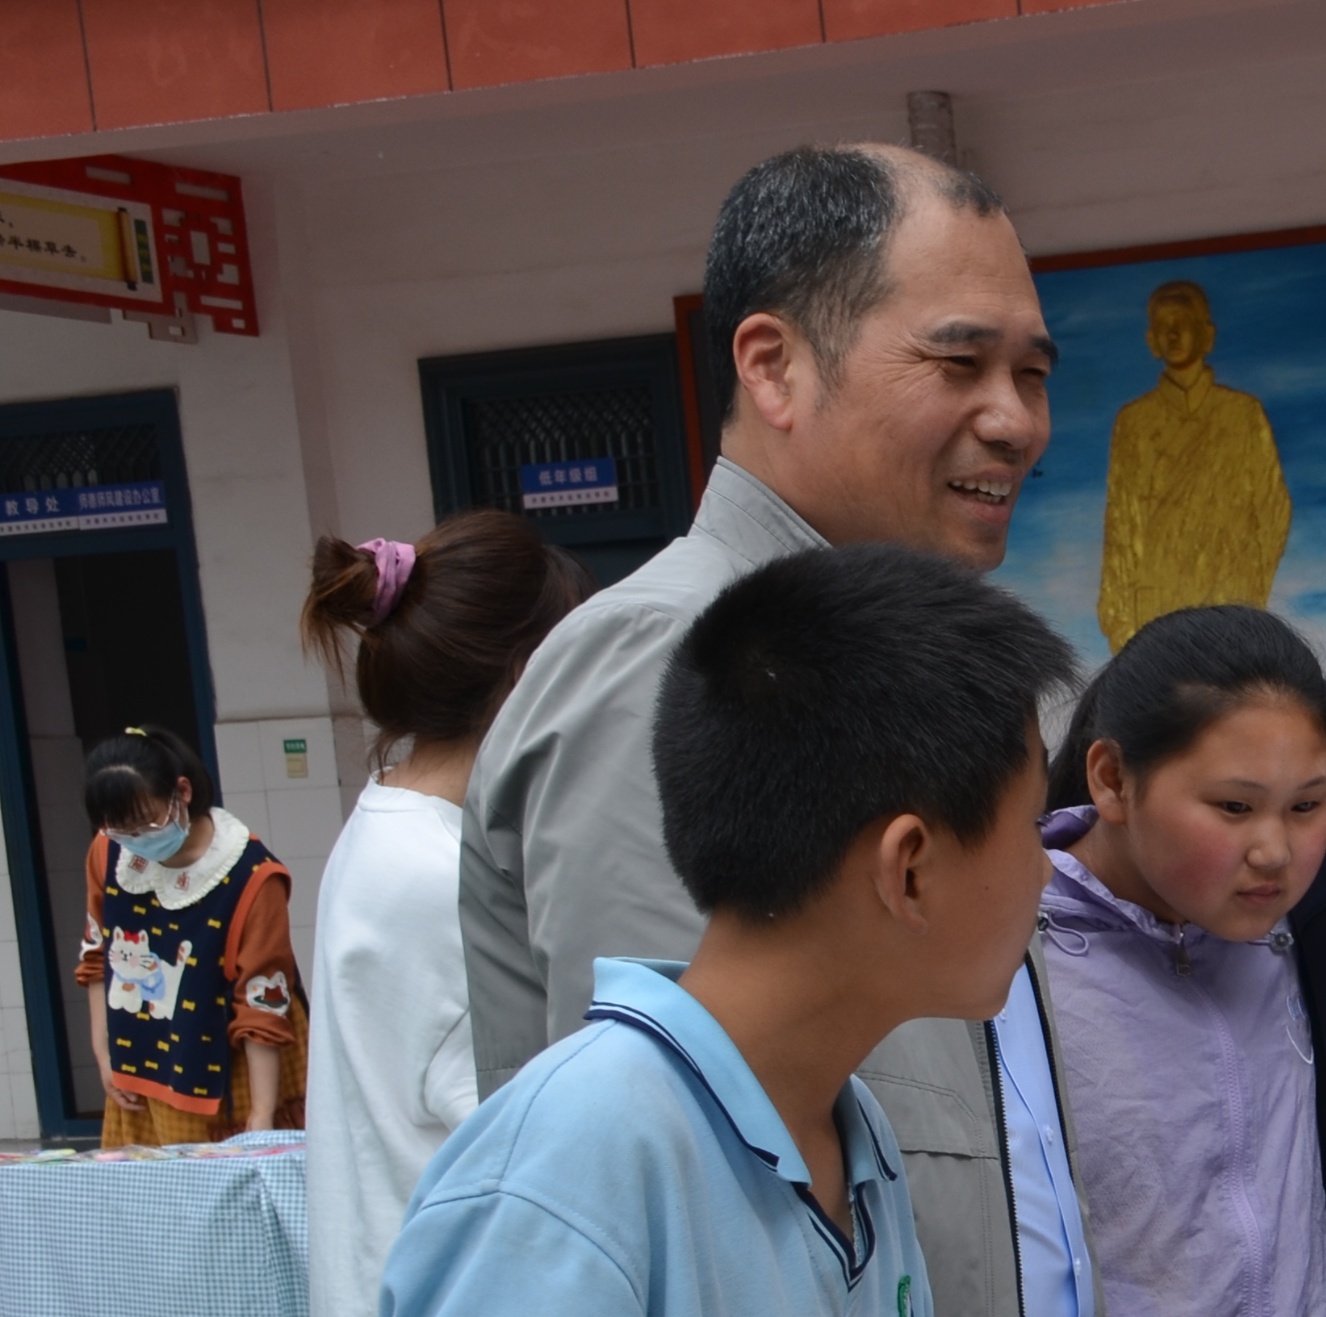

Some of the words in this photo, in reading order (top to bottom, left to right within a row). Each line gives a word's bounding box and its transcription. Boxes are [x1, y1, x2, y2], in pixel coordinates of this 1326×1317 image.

[539, 466, 598, 486] 低年级组
[5, 495, 60, 517] 教导处
